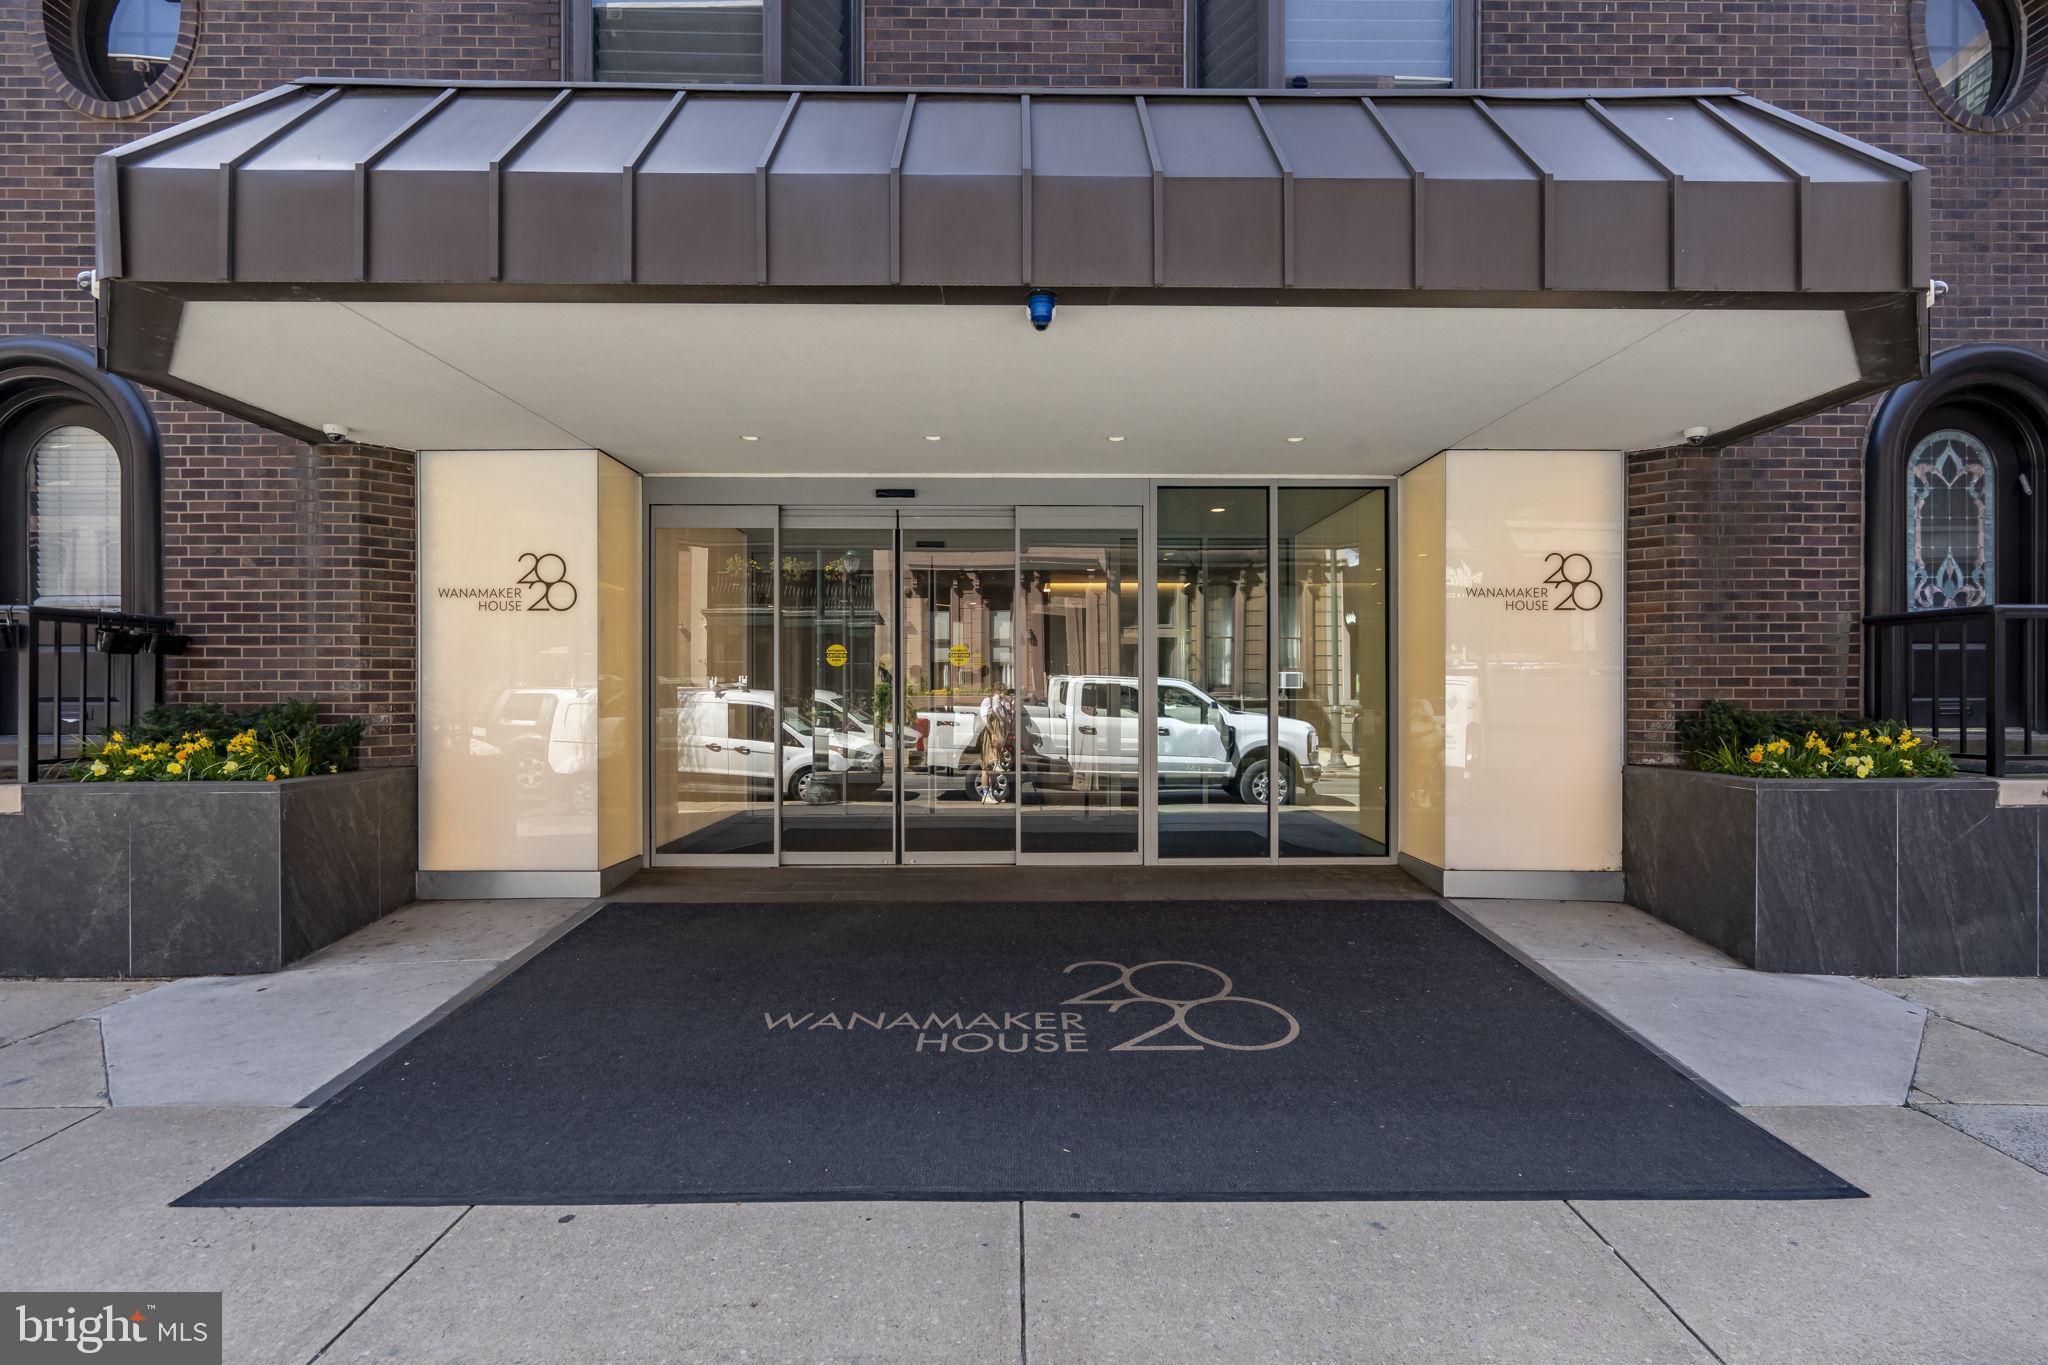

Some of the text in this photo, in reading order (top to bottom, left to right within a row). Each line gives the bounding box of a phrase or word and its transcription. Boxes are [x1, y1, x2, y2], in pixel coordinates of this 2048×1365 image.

[516, 552, 567, 584] 20
[1543, 552, 1593, 584] 20
[438, 587, 522, 599] WANAMAKER
[526, 580, 578, 611] 20
[1465, 587, 1549, 598] WANAMAKER
[1505, 600, 1549, 611] HOUSE
[1553, 580, 1603, 611] 20
[478, 600, 522, 612] HOUSE
[1060, 960, 1233, 1005] 20
[762, 1011, 1089, 1030] WANAMAKER
[1108, 995, 1300, 1052] 20
[914, 1032, 1089, 1053] HOUSE
